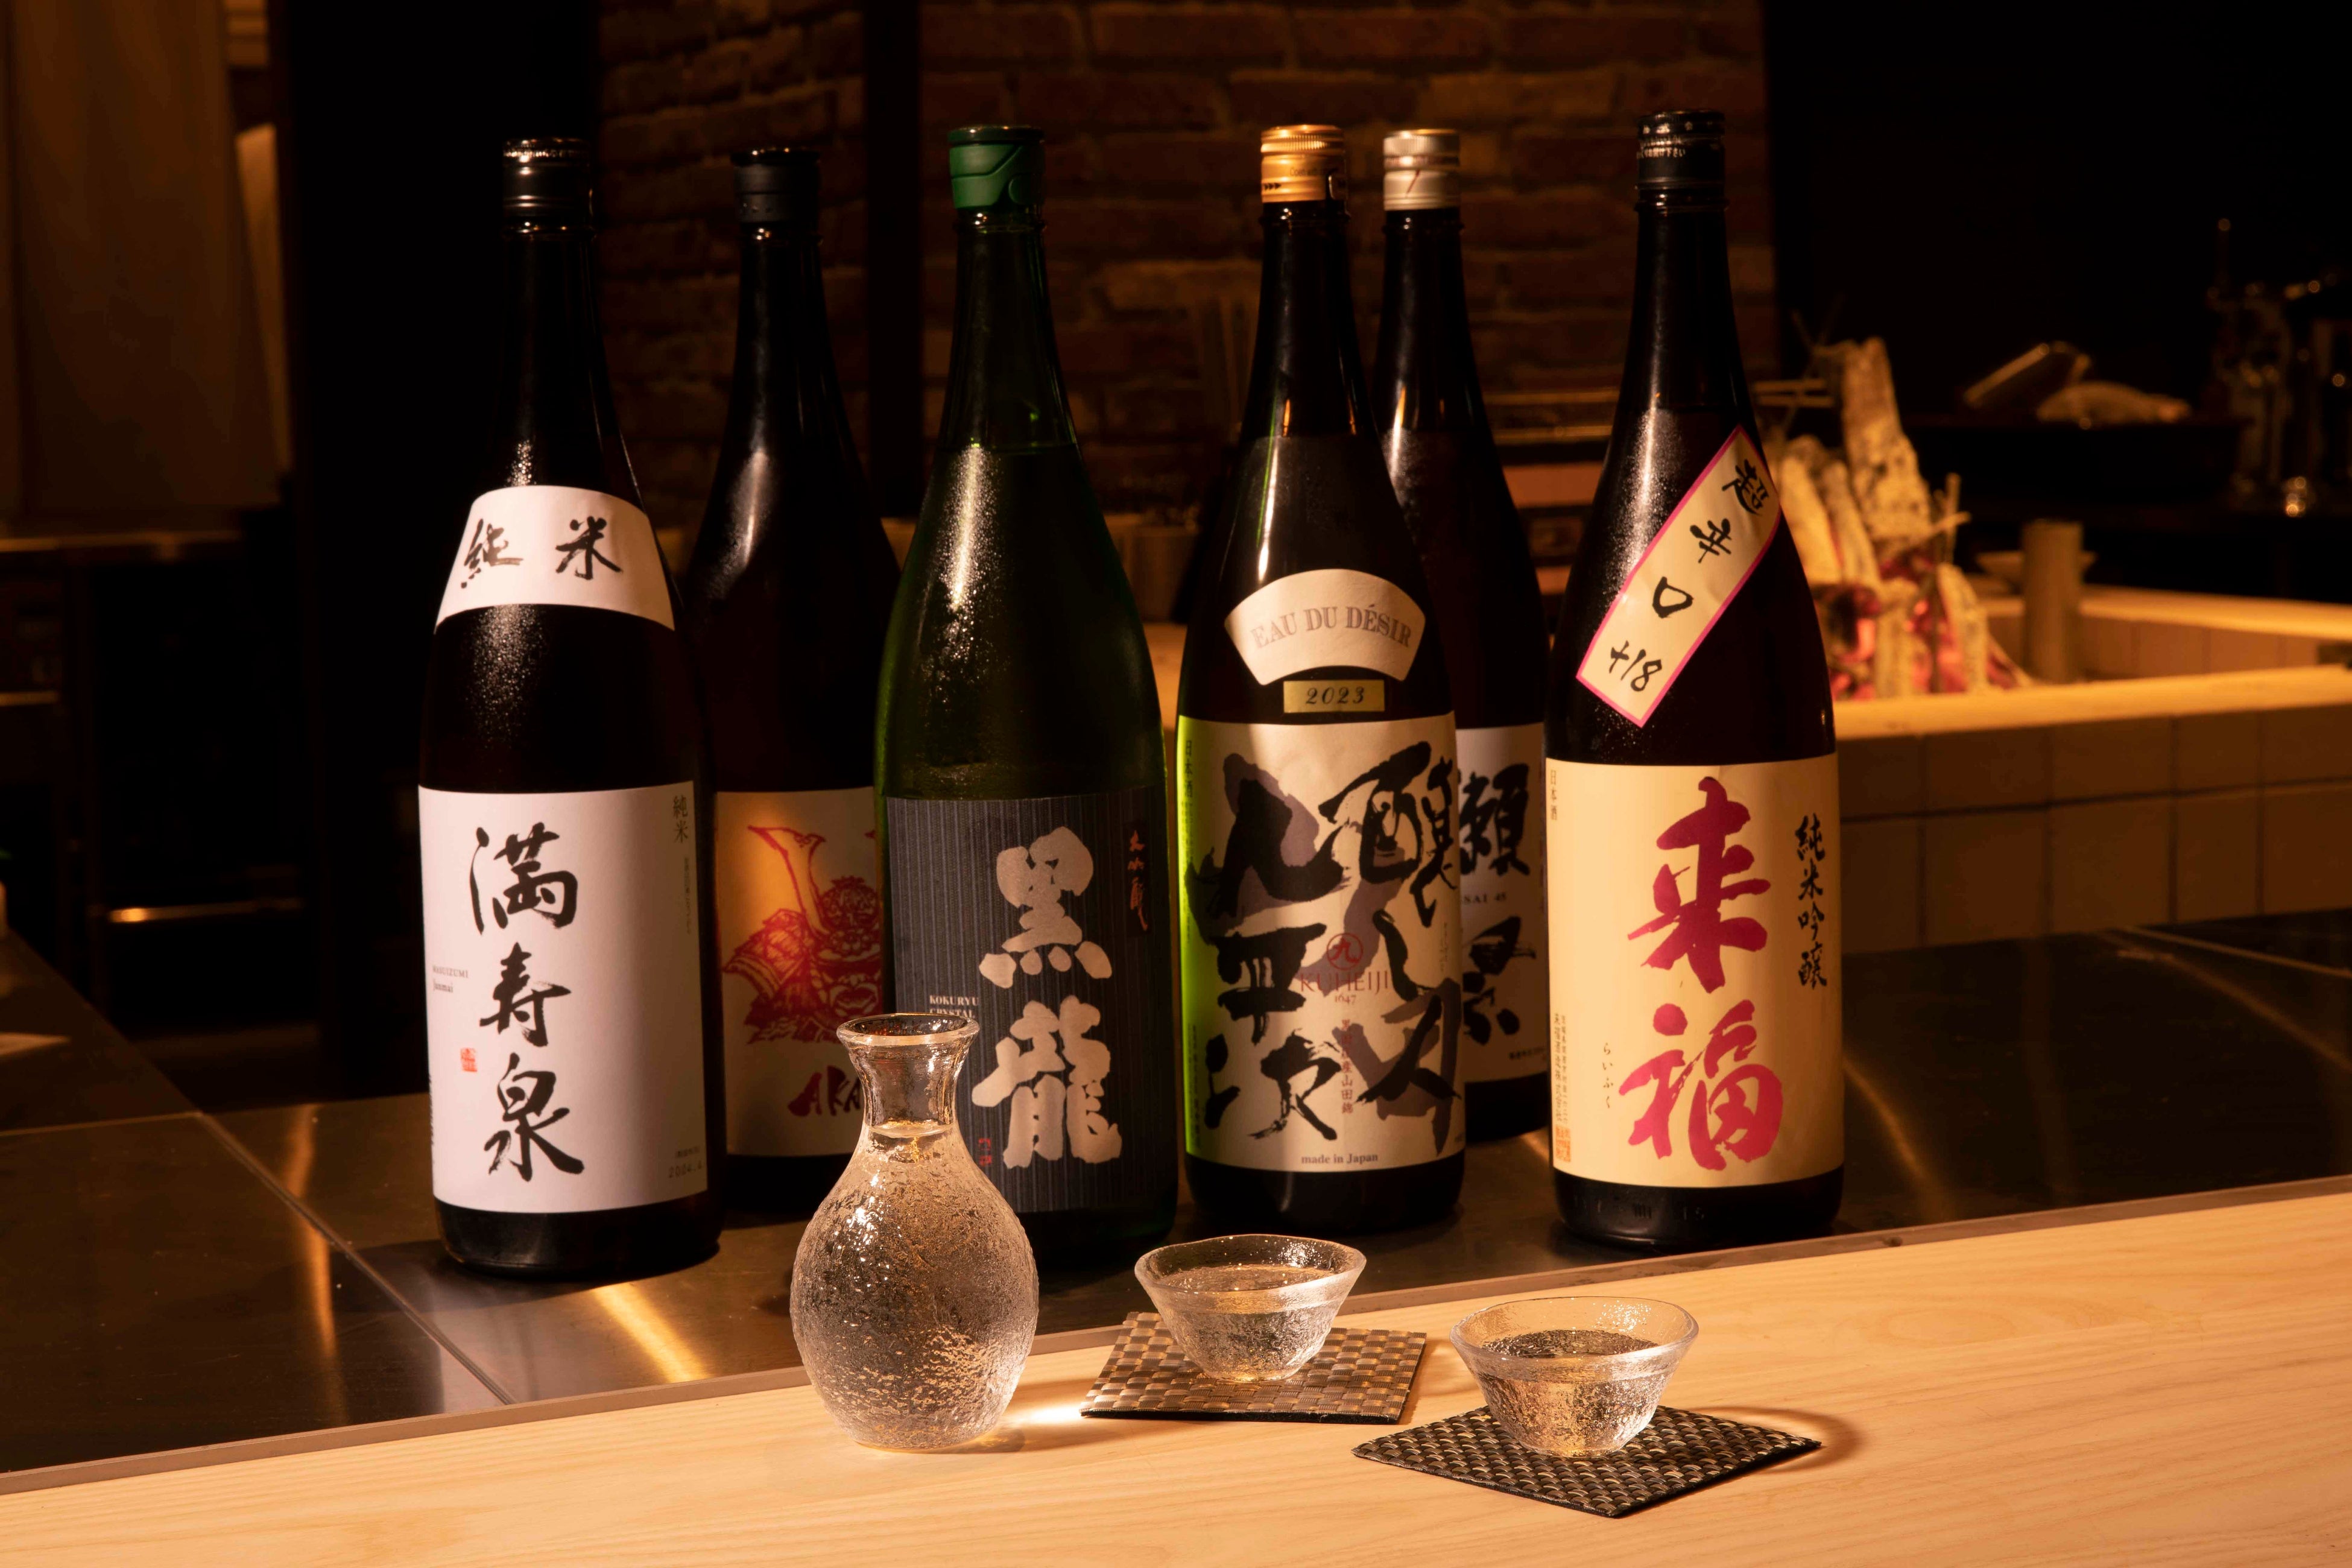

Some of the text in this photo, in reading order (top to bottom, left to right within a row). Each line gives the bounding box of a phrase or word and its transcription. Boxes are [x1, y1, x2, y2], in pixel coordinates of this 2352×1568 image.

[461, 516, 623, 589] 純米
[1250, 604, 1412, 649] EAU DU DÉSIR
[1306, 686, 1365, 704] 2023
[672, 794, 689, 843] 純米
[1795, 812, 1827, 990] 純米吟醸
[1300, 970, 1388, 995] KUHEIJI
[1619, 776, 1783, 1171] 来福
[470, 822, 585, 1182] 満寿泉
[929, 994, 979, 1007] KOKURYU
[788, 1065, 861, 1117] AKA
[1601, 1042, 1616, 1110] らいふく
[1301, 1153, 1378, 1165] made in Japan
